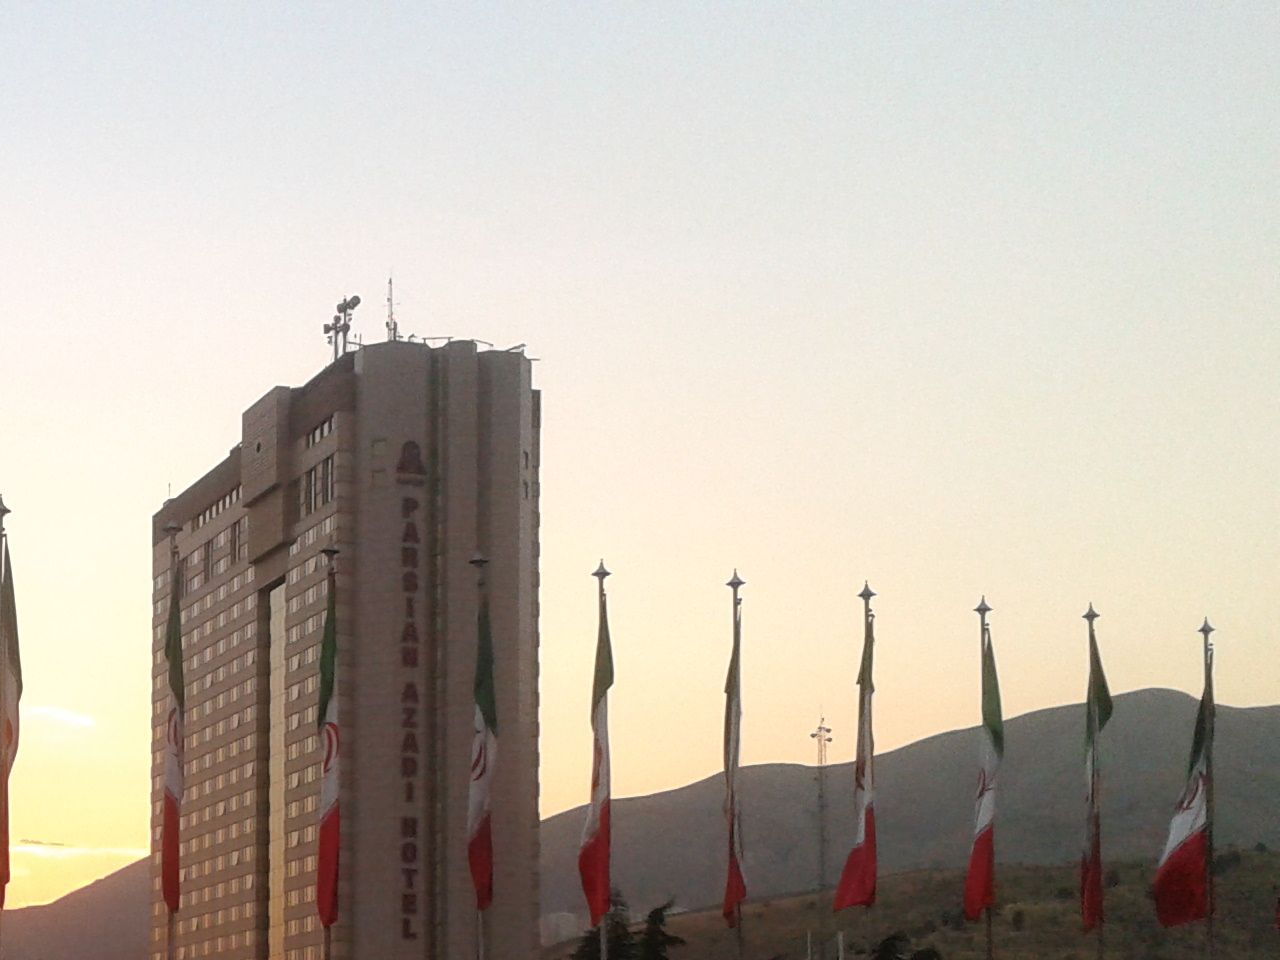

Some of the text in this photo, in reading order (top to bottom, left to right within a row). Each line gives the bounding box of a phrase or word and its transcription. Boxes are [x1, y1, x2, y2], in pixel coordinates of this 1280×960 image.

[400, 497, 419, 940] PARSIAN AZADI HOTEL
